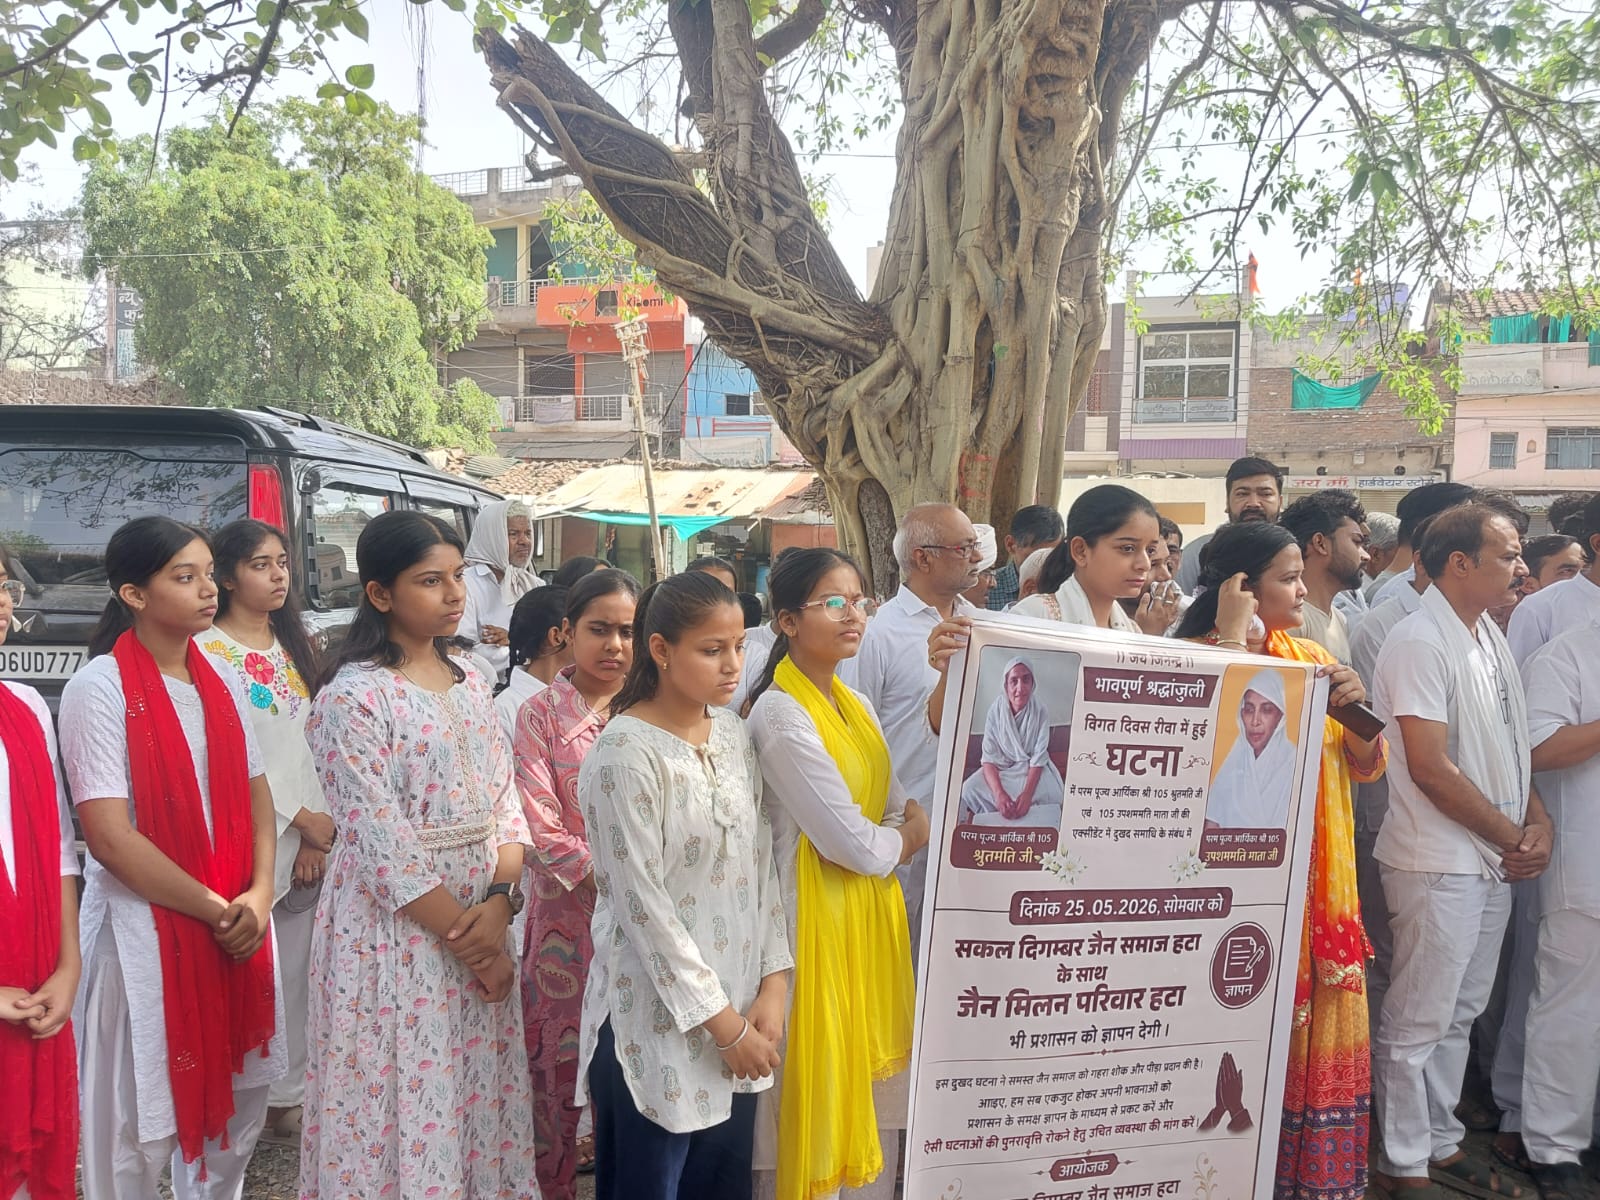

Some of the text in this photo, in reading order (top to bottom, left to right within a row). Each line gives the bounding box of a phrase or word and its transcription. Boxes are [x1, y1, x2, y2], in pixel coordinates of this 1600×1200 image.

[1095, 675, 1144, 699] भावपूर्ण
[1084, 713, 1208, 740] विगत दिवस रीवा में हुई
[1106, 743, 1184, 777] घटना
[1078, 787, 1093, 797] परम
[1094, 787, 1110, 800] पूज्य
[1142, 786, 1151, 798] श्री
[1153, 789, 1168, 799] 105
[1195, 787, 1203, 799] जी
[1081, 807, 1093, 819] एवं
[1099, 809, 1114, 818] 105
[1153, 809, 1169, 819] माता
[1170, 808, 1179, 819] जी
[1181, 808, 1190, 819] की
[961, 831, 977, 840] परम
[980, 833, 996, 845] पूज्य
[1027, 832, 1035, 843] श्री
[1038, 834, 1052, 843] 105
[1113, 829, 1131, 841] दुखद
[1133, 827, 1157, 839] समाधि
[1159, 826, 1166, 839] के
[1168, 828, 1184, 839] संबंध
[1268, 834, 1280, 844] 105
[973, 846, 1033, 867] श्रुतमति जी
[1205, 847, 1278, 862] उपशममति माता जी
[1019, 897, 1061, 919] दिनांक
[1164, 895, 1205, 912] सोमवार
[1207, 893, 1224, 912] को
[955, 930, 1202, 960] सकल दिगम्बर जैन समाज हटा
[1057, 963, 1108, 983] के साथ
[957, 983, 1186, 1018] जैन मिलन परिवार हटा
[1224, 984, 1253, 998] ज्ञापन
[1009, 1030, 1027, 1049] भी
[1030, 1031, 1077, 1048] प्रशासन
[1081, 1025, 1098, 1044] को
[1101, 1024, 1135, 1043] ज्ञापन
[935, 1079, 950, 1090] इस
[975, 1077, 997, 1087] घटना
[1000, 1074, 1007, 1086] ने
[1008, 1075, 1034, 1086] समस्त
[1036, 1072, 1050, 1084] जैन
[1052, 1071, 1076, 1082] समाज
[1078, 1068, 1089, 1080] को
[1090, 1069, 1109, 1079] गहरा
[1111, 1065, 1129, 1076] शोक
[1130, 1062, 1145, 1075] और
[1146, 1061, 1161, 1074] पीड़ा
[1163, 1061, 1181, 1072] प्रदान
[1182, 1058, 1192, 1070] की
[1010, 1096, 1024, 1108] हम
[1027, 1095, 1041, 1105] सब
[1044, 1092, 1074, 1105] एकजुट
[1075, 1088, 1098, 1102] होकर
[1100, 1084, 1123, 1098] अपनी
[1125, 1080, 1158, 1096] भावनाओं
[1160, 1080, 1172, 1092] को
[968, 1099, 1174, 1129] प्रशासन के समक्ष ज्ञापन के माध्यम से प्रकट करें और
[923, 1138, 943, 1154] ऐसी
[945, 1136, 984, 1151] घटनाओं
[986, 1135, 1000, 1148] की
[1045, 1128, 1070, 1143] रोकने
[1073, 1127, 1087, 1143] हेतु
[1089, 1124, 1112, 1138] उचित
[1115, 1122, 1147, 1135] व्यवस्था
[1149, 1118, 1161, 1131] की
[1163, 1117, 1179, 1130] मांग
[1058, 1158, 1110, 1177] आयोजक
[1113, 1183, 1154, 1200] समाज
[1157, 1179, 1181, 1197] हटा
